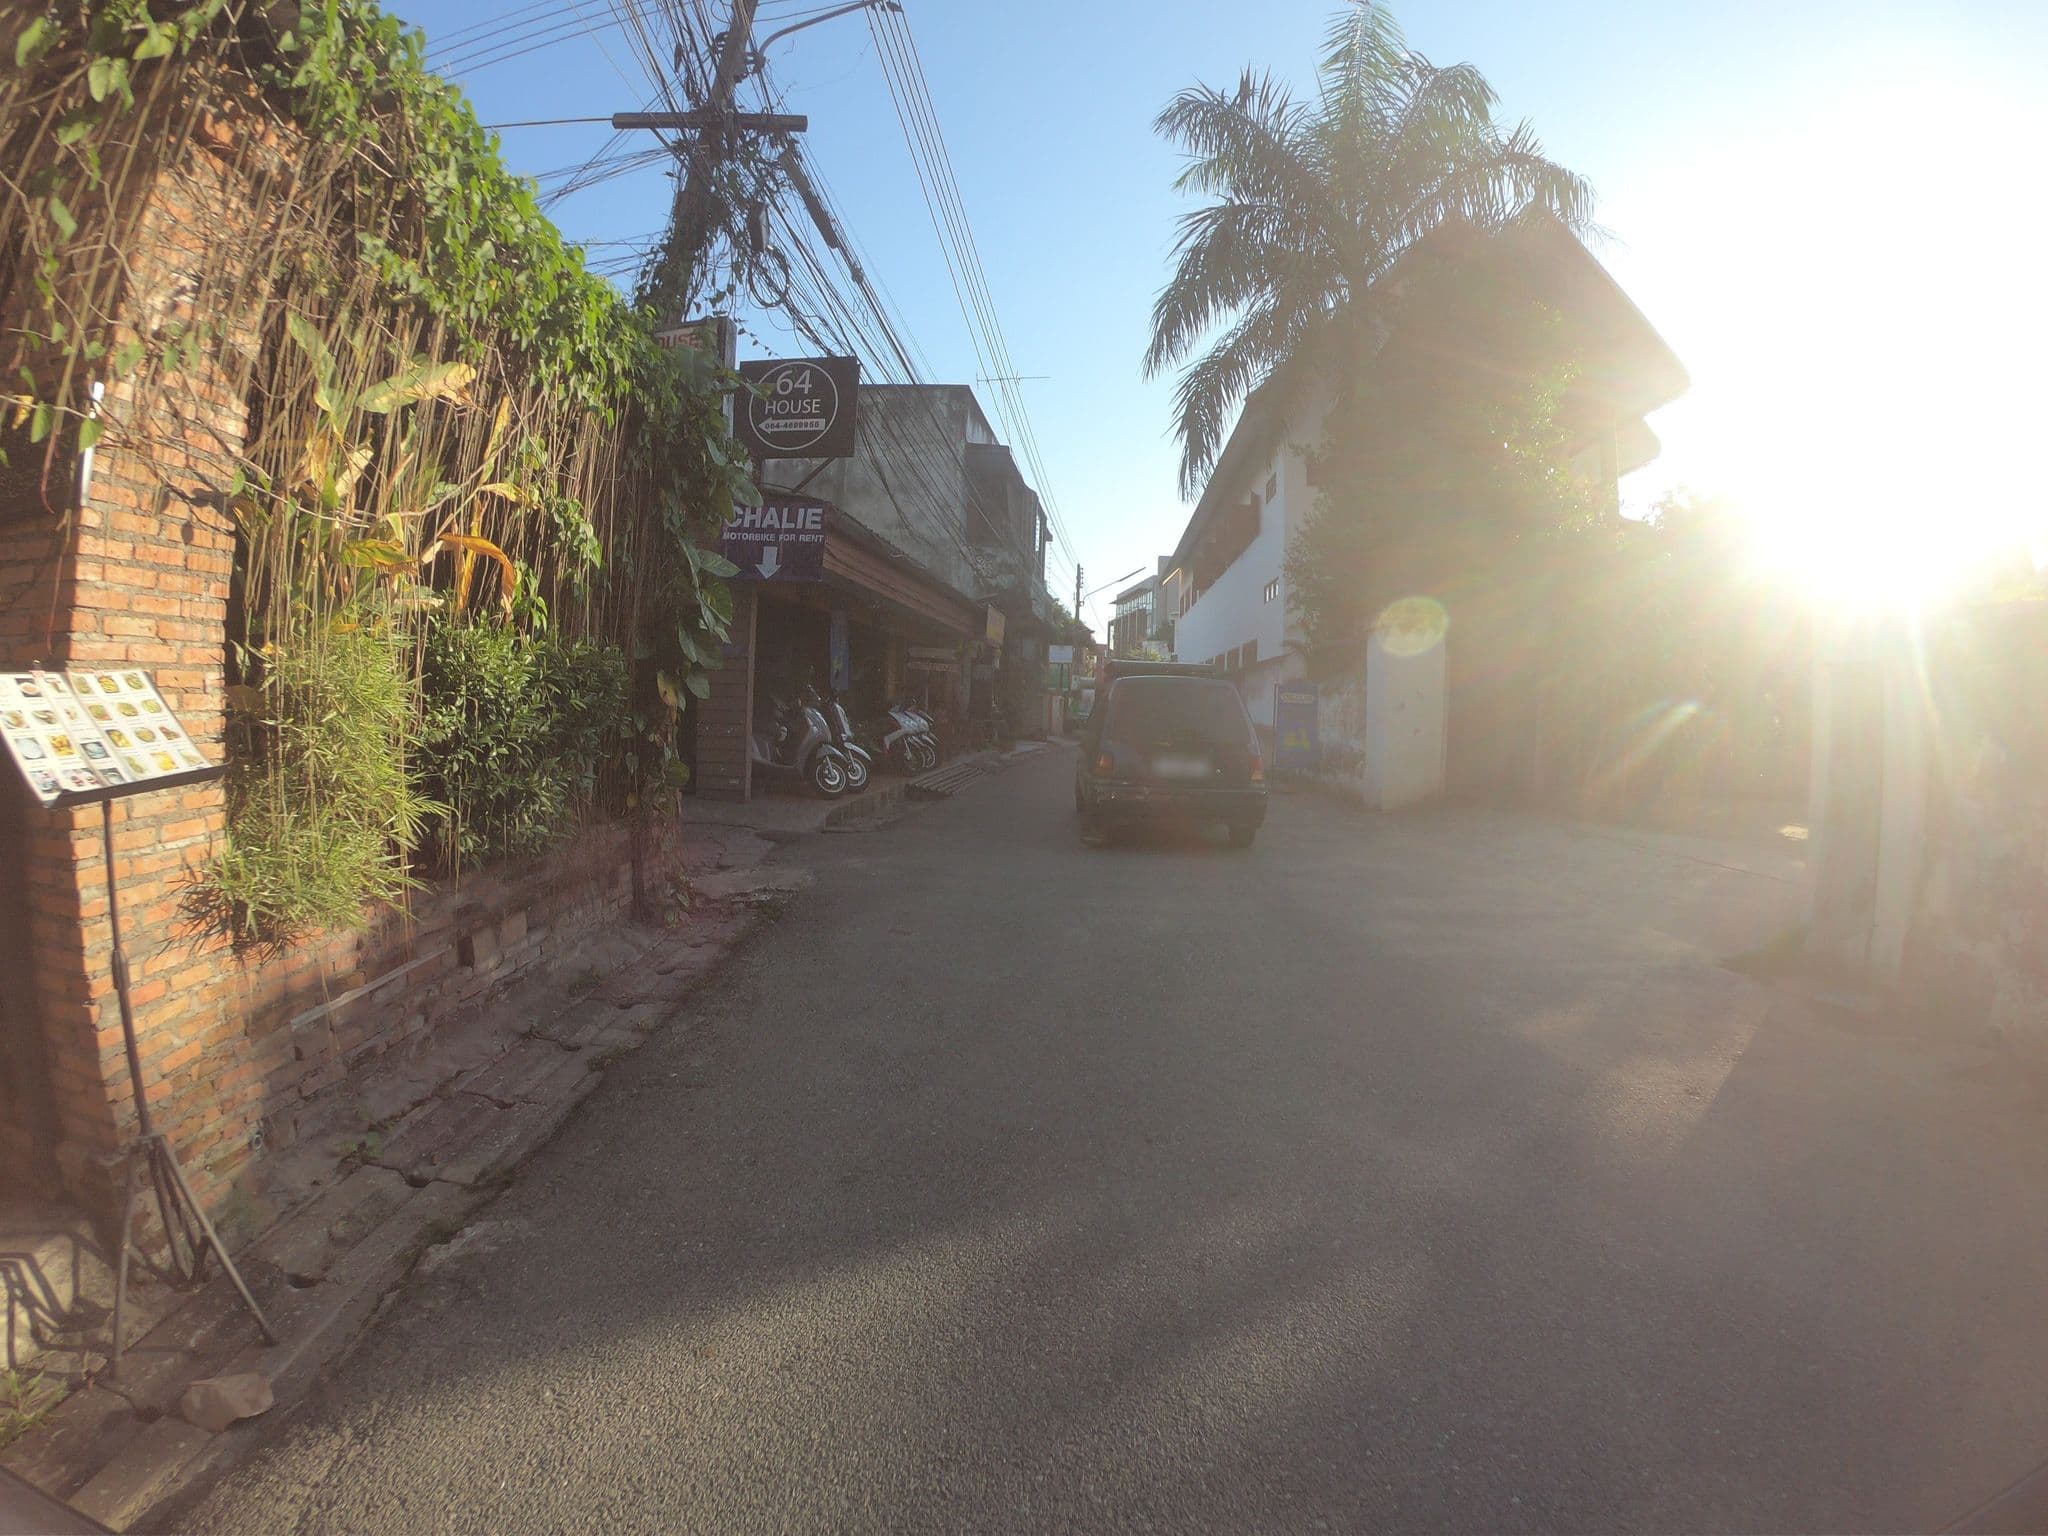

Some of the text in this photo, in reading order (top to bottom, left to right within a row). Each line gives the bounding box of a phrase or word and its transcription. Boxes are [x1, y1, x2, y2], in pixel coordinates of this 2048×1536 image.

[776, 369, 812, 395] 64
[765, 398, 821, 415] HOUSE
[725, 505, 823, 530] CHALIE
[722, 531, 824, 543] MOTORBIKE FOR RENT
